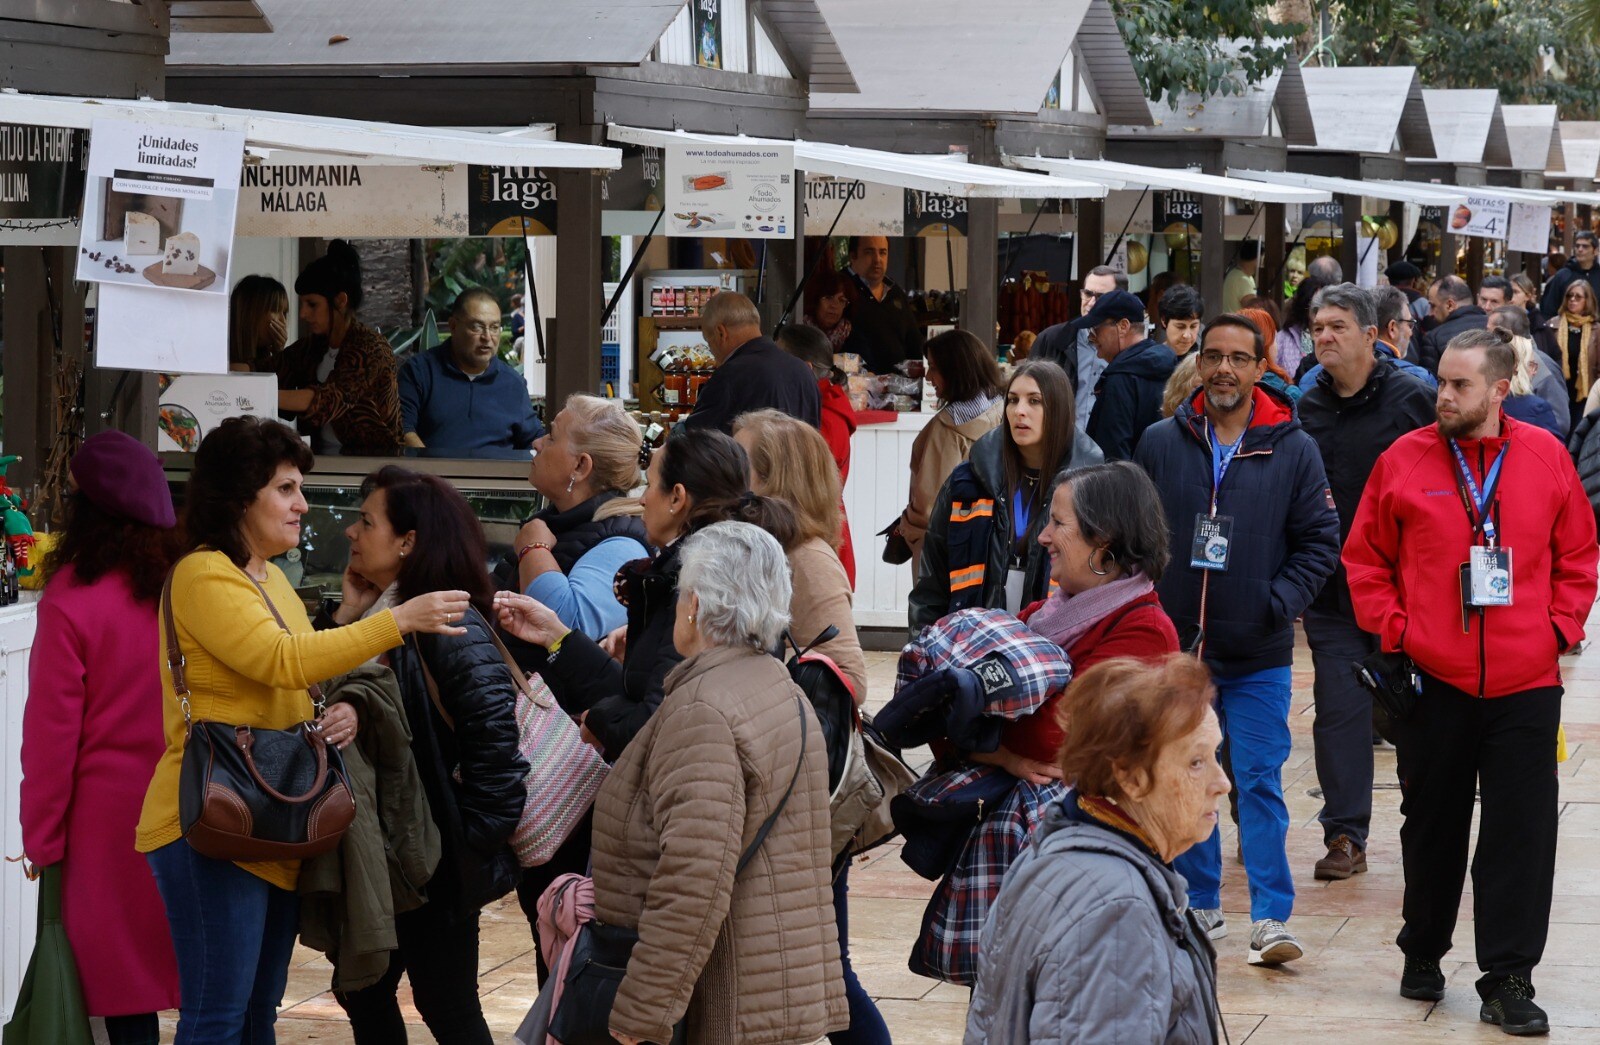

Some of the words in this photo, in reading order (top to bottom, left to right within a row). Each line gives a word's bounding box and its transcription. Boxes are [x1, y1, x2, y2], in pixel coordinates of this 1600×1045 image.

[0, 126, 24, 161] TIJO
[27, 127, 41, 161] LA
[44, 128, 75, 162] FUENTE
[138, 134, 199, 153] ¡Unidades
[685, 149, 779, 158] www.todoahumados.com
[137, 151, 197, 168] limitadas!
[642, 153, 660, 188] laga
[261, 187, 328, 212] MÁLAGA
[491, 172, 557, 210] laga
[749, 195, 781, 203] Ahumados
[921, 191, 968, 219] laga
[1166, 197, 1202, 219] laga
[1485, 217, 1496, 234] 4
